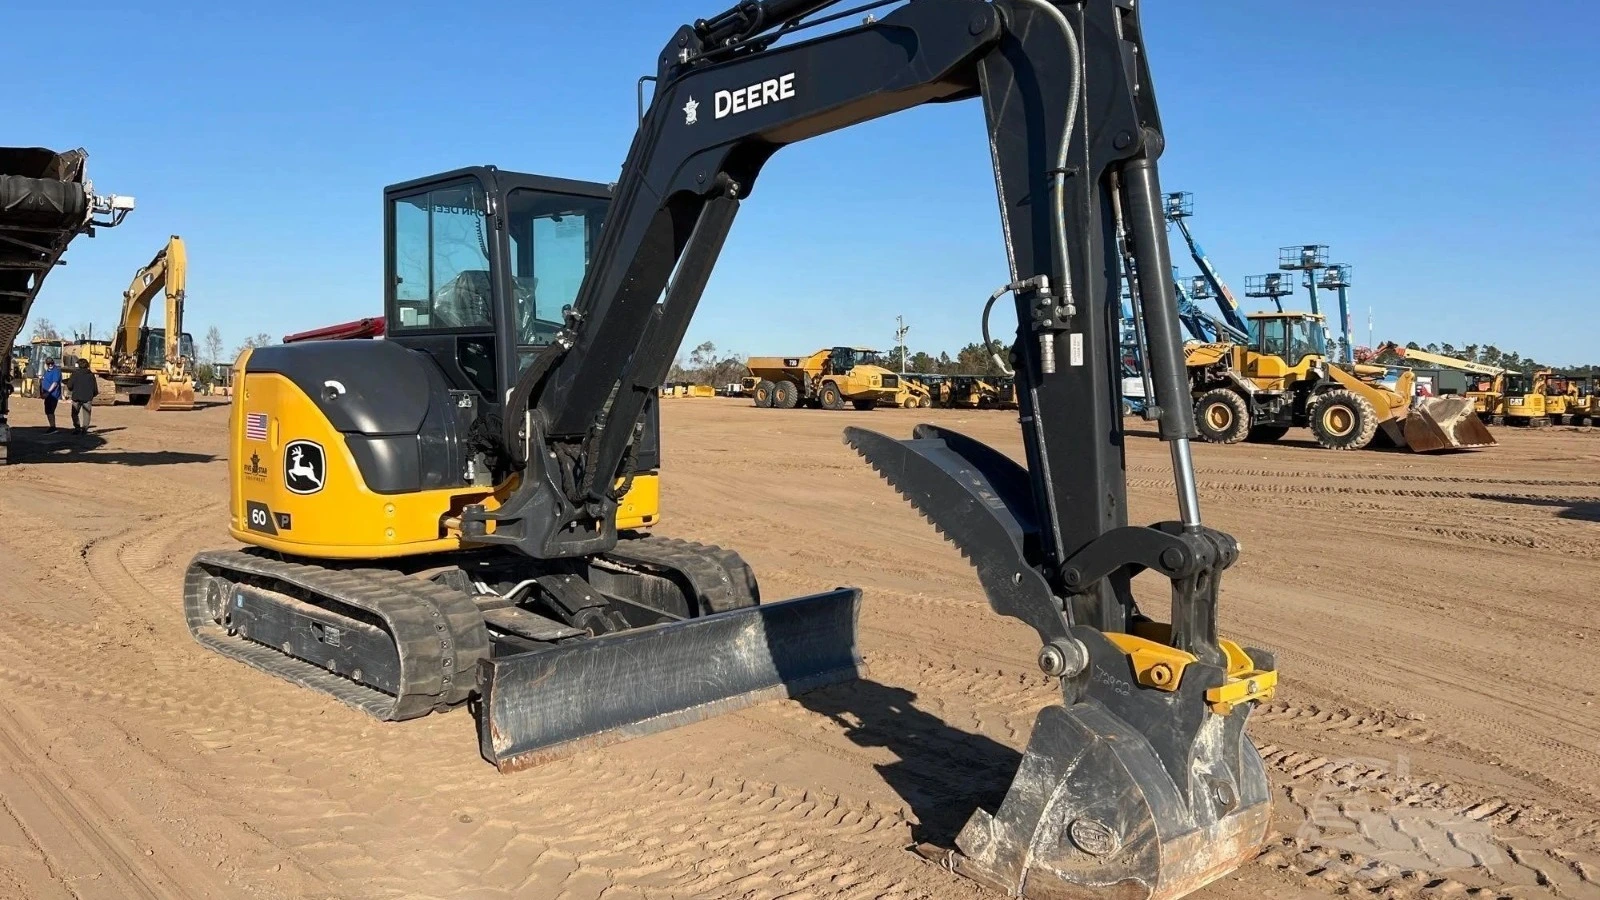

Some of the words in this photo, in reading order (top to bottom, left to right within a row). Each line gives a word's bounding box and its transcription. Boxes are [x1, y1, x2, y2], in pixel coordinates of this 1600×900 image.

[714, 72, 795, 119] DEERE
[252, 508, 267, 526] 60
[281, 515, 289, 528] P
